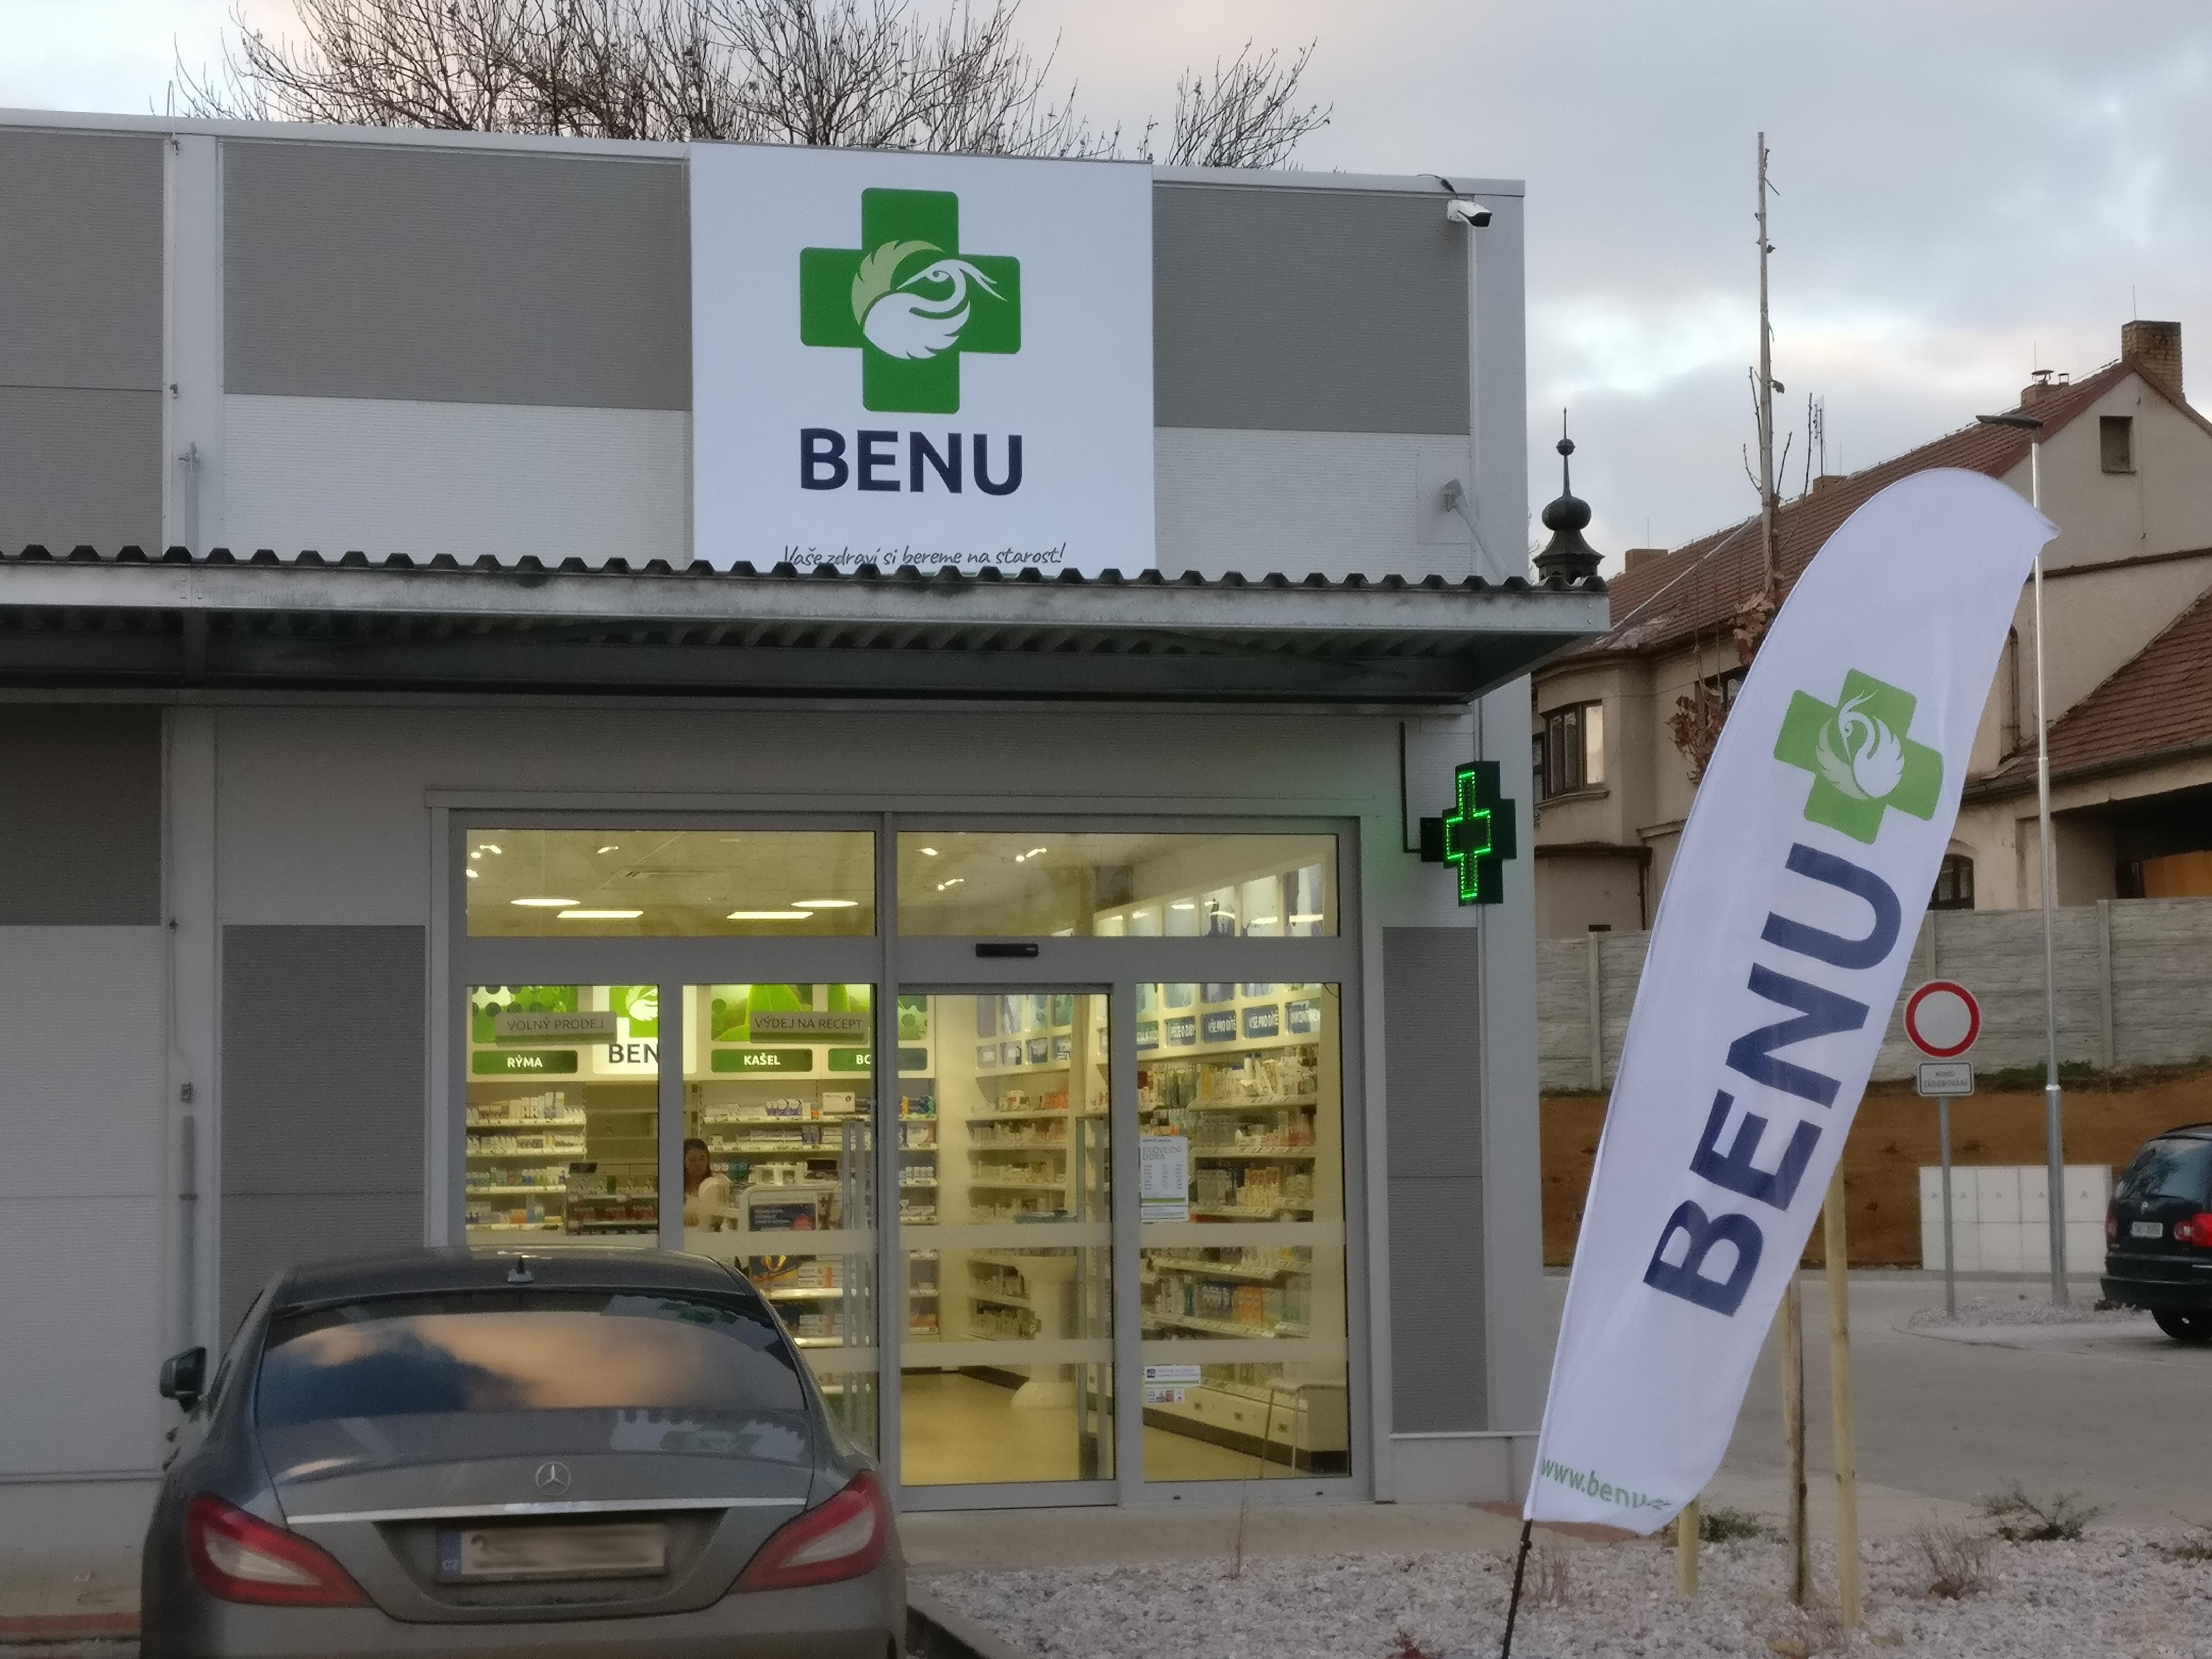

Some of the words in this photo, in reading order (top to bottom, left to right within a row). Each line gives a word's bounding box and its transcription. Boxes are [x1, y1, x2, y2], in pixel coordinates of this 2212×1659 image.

[800, 428, 1023, 496] BENU
[785, 545, 822, 566] Vaše
[828, 546, 881, 566] zdraví
[884, 548, 898, 565] si
[902, 545, 962, 565] bereme
[967, 552, 991, 564] na
[996, 541, 1067, 565] starost!
[507, 1016, 551, 1031] VOLNÝ
[554, 1018, 604, 1030] PRODEJ
[754, 1016, 794, 1029] VÝDEJ
[798, 1018, 815, 1029] NA
[818, 1019, 863, 1029] RECEPT
[507, 1054, 543, 1068] RÝMA
[609, 1044, 659, 1063] BEN
[744, 1052, 781, 1066] KAŠEL
[1642, 842, 1901, 1318] BENU
